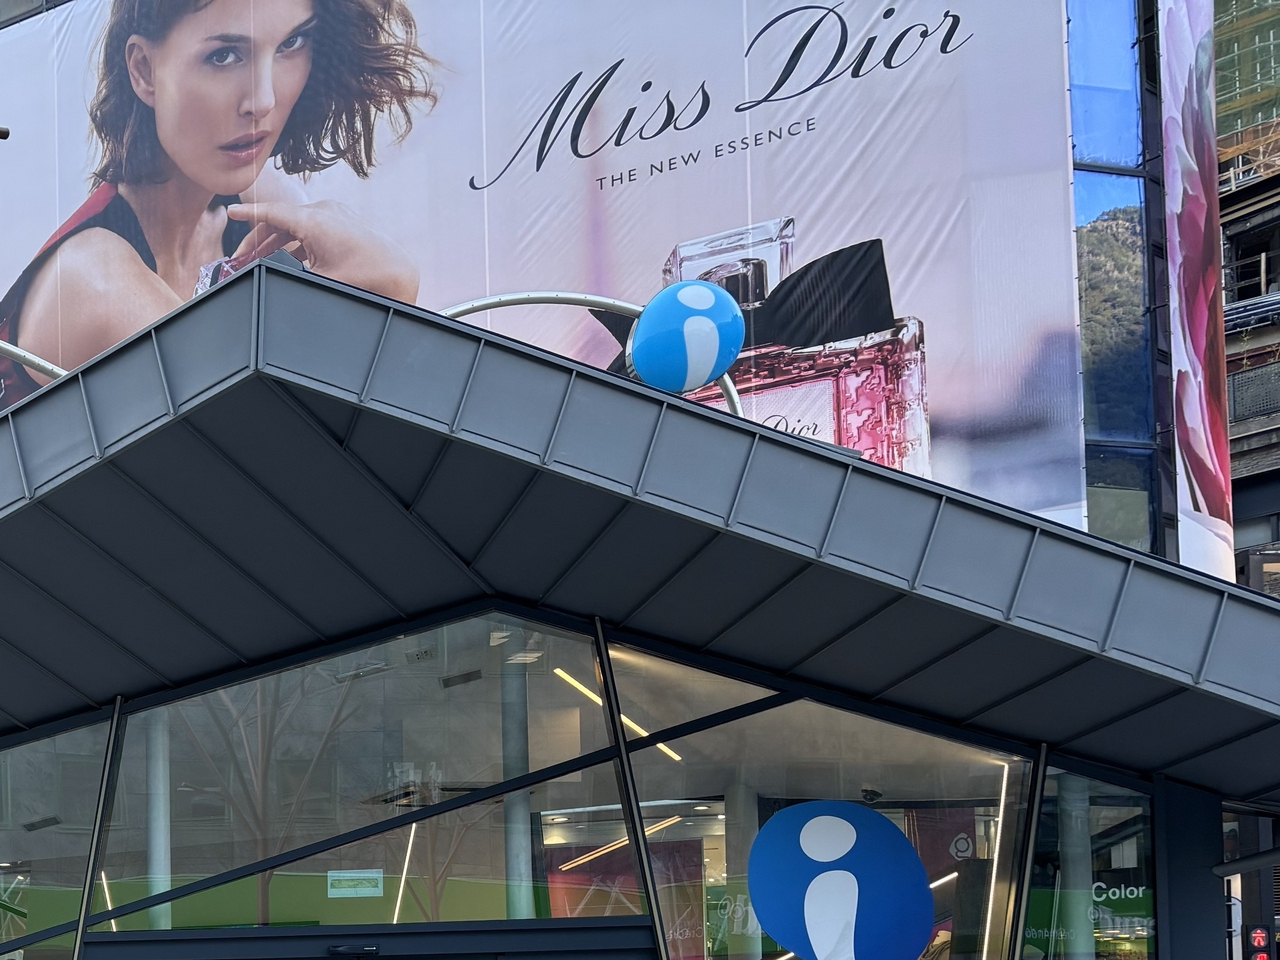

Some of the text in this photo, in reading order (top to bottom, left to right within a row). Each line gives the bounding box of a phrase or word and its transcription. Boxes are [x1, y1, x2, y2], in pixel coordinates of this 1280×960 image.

[469, 1, 974, 190] Miss Dior
[596, 116, 818, 191] THE NEW ESSENCE
[761, 414, 822, 437] Dior
[1092, 881, 1146, 902] Color
